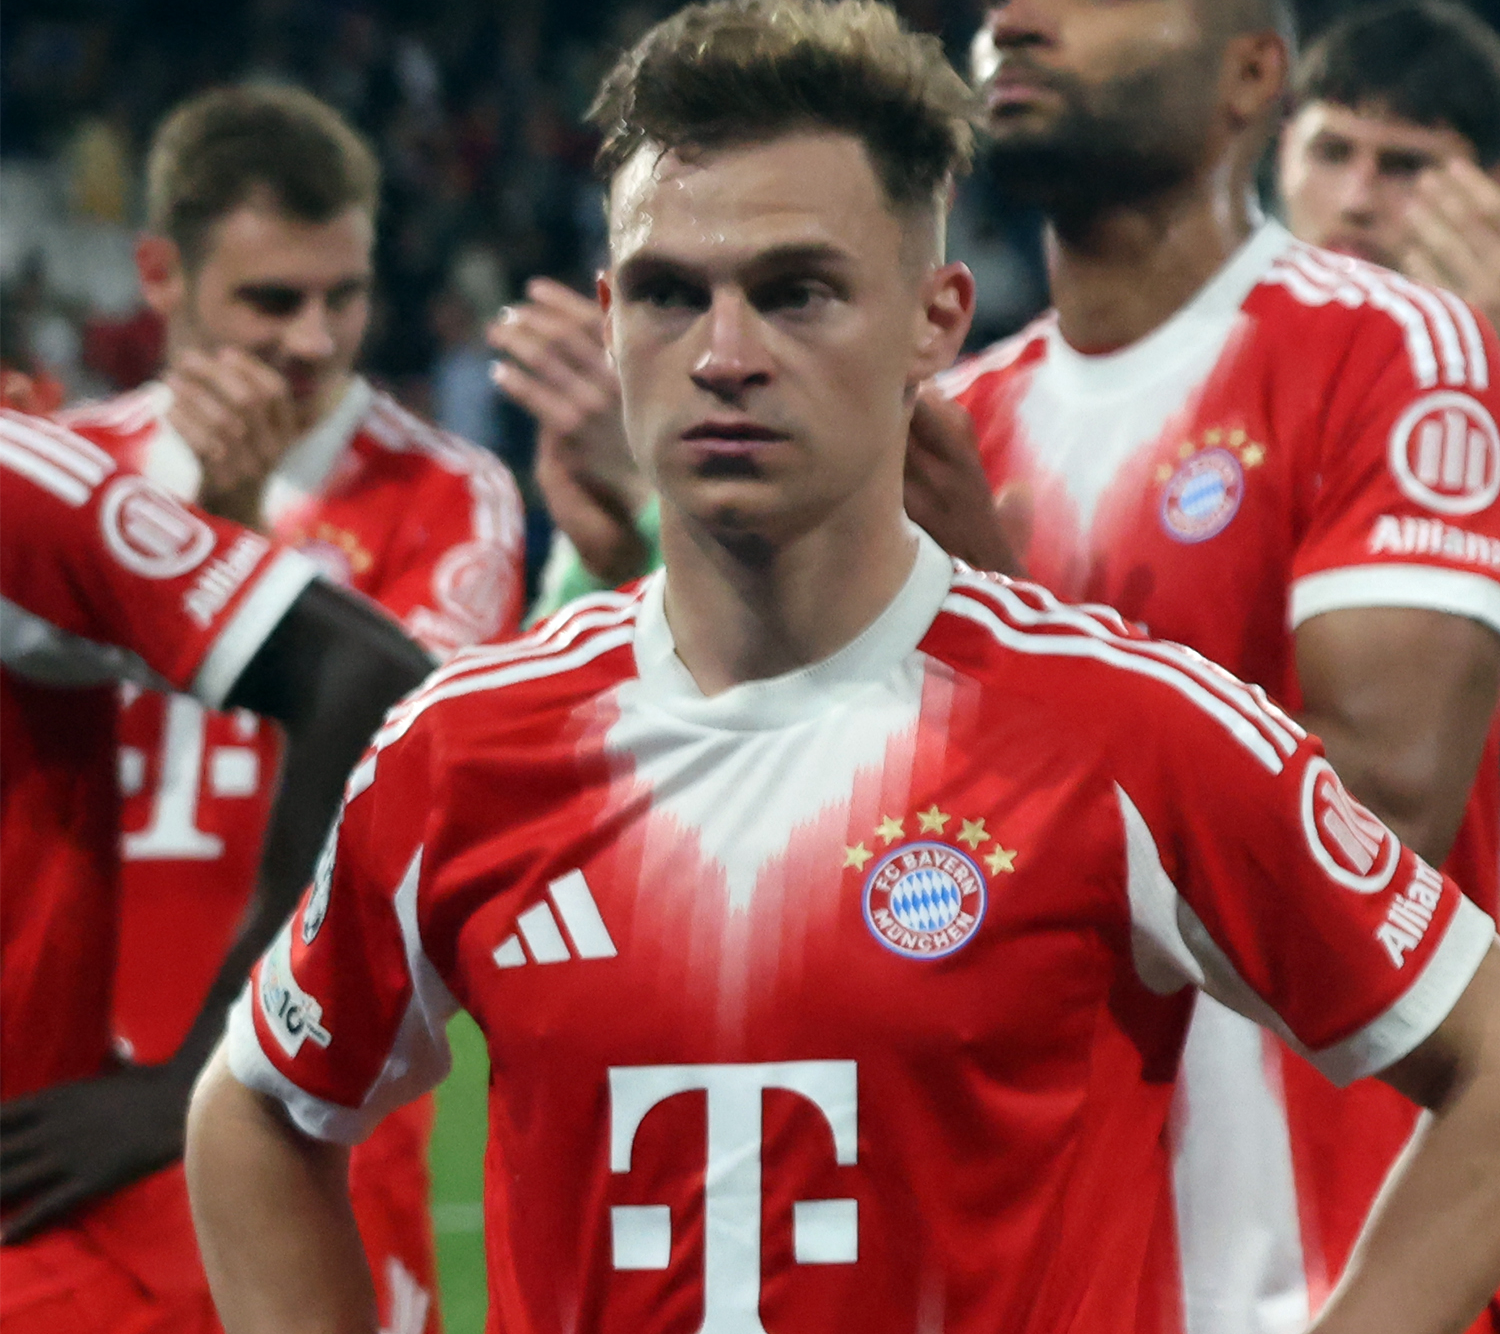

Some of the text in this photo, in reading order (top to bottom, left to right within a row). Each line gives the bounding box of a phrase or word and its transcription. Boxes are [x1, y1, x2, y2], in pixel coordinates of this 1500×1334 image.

[875, 848, 978, 896] FC BAYERN
[872, 907, 976, 952] MÜNCHEN
[1376, 853, 1445, 970] Allian
